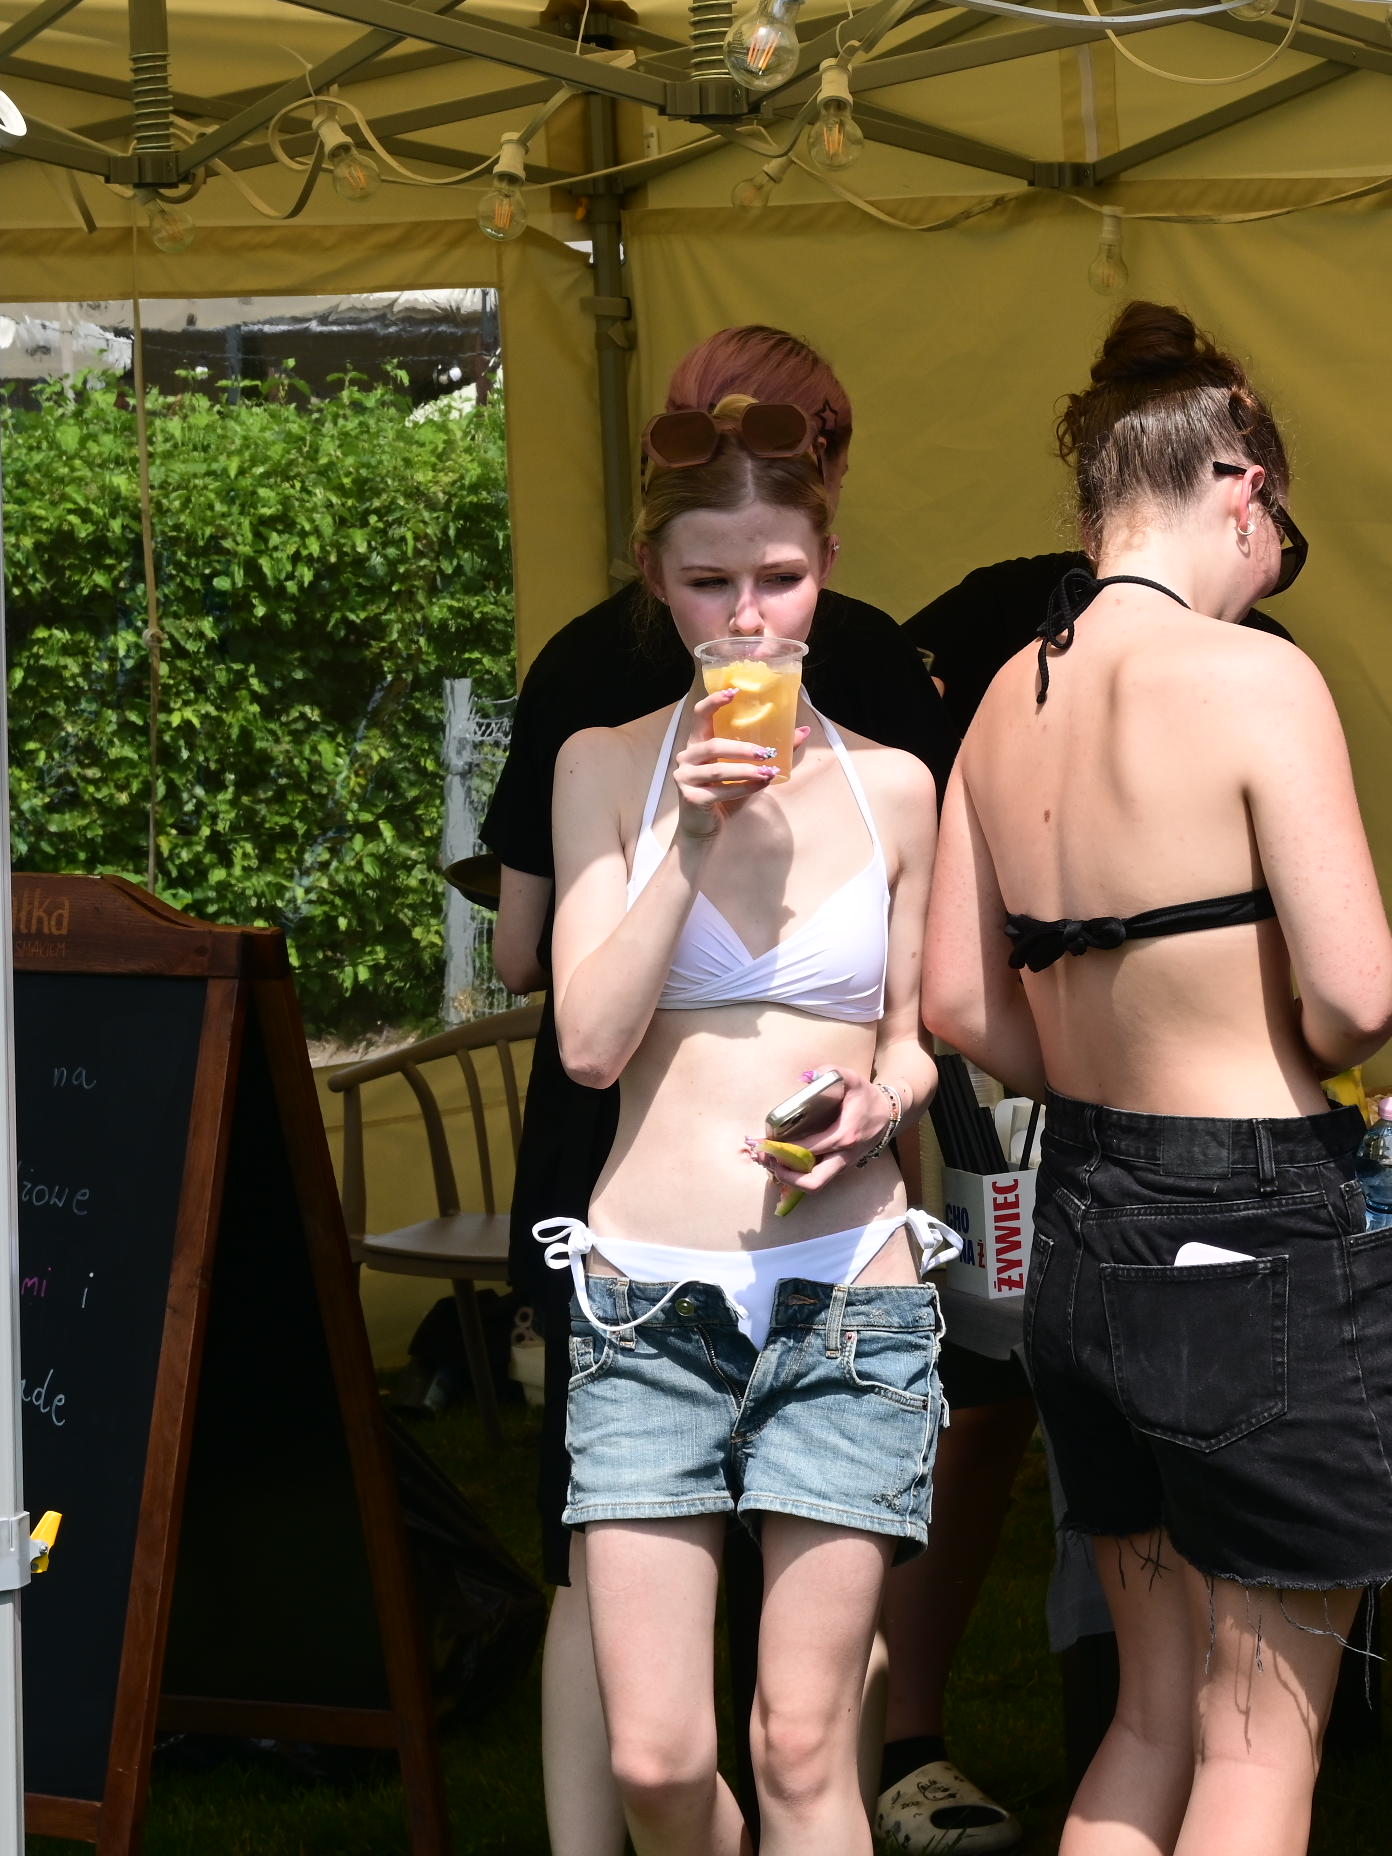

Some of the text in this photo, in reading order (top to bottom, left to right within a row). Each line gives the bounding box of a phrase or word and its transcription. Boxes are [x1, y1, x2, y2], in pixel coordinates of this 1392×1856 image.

[53, 1065, 96, 1089] na
[20, 1165, 91, 1216] żowe
[991, 1178, 1024, 1293] ŻYWIEC
[21, 1266, 94, 1309] mi i
